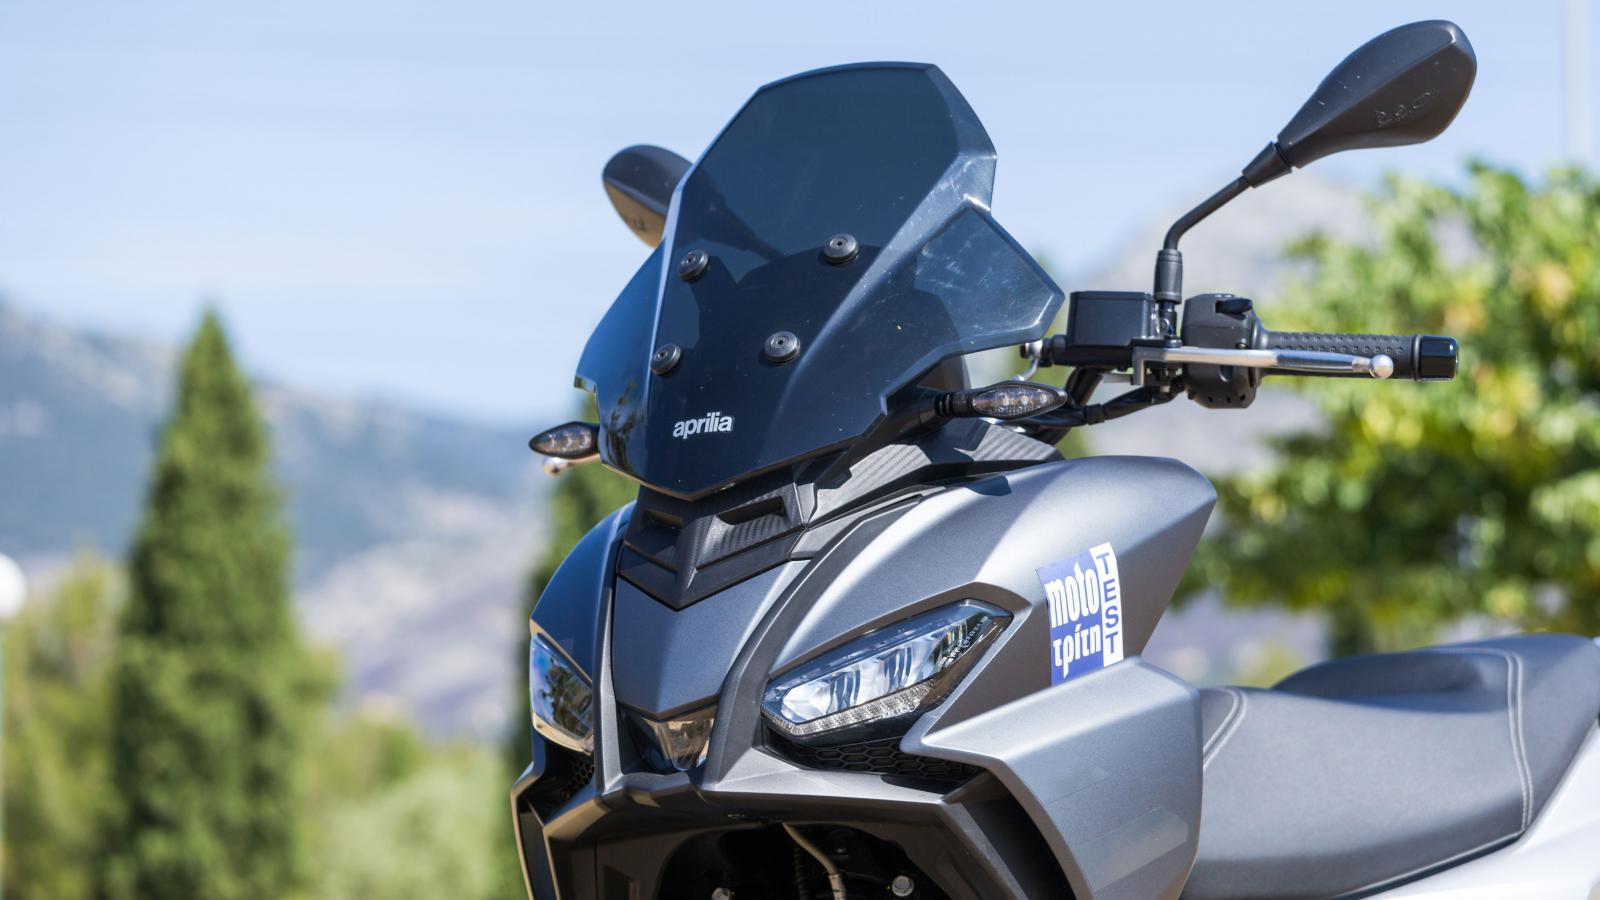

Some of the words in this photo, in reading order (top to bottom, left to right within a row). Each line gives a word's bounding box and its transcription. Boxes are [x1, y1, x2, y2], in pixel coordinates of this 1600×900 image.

[672, 411, 733, 440] aprilia
[1045, 561, 1100, 628] moto
[1096, 552, 1119, 654] TEST
